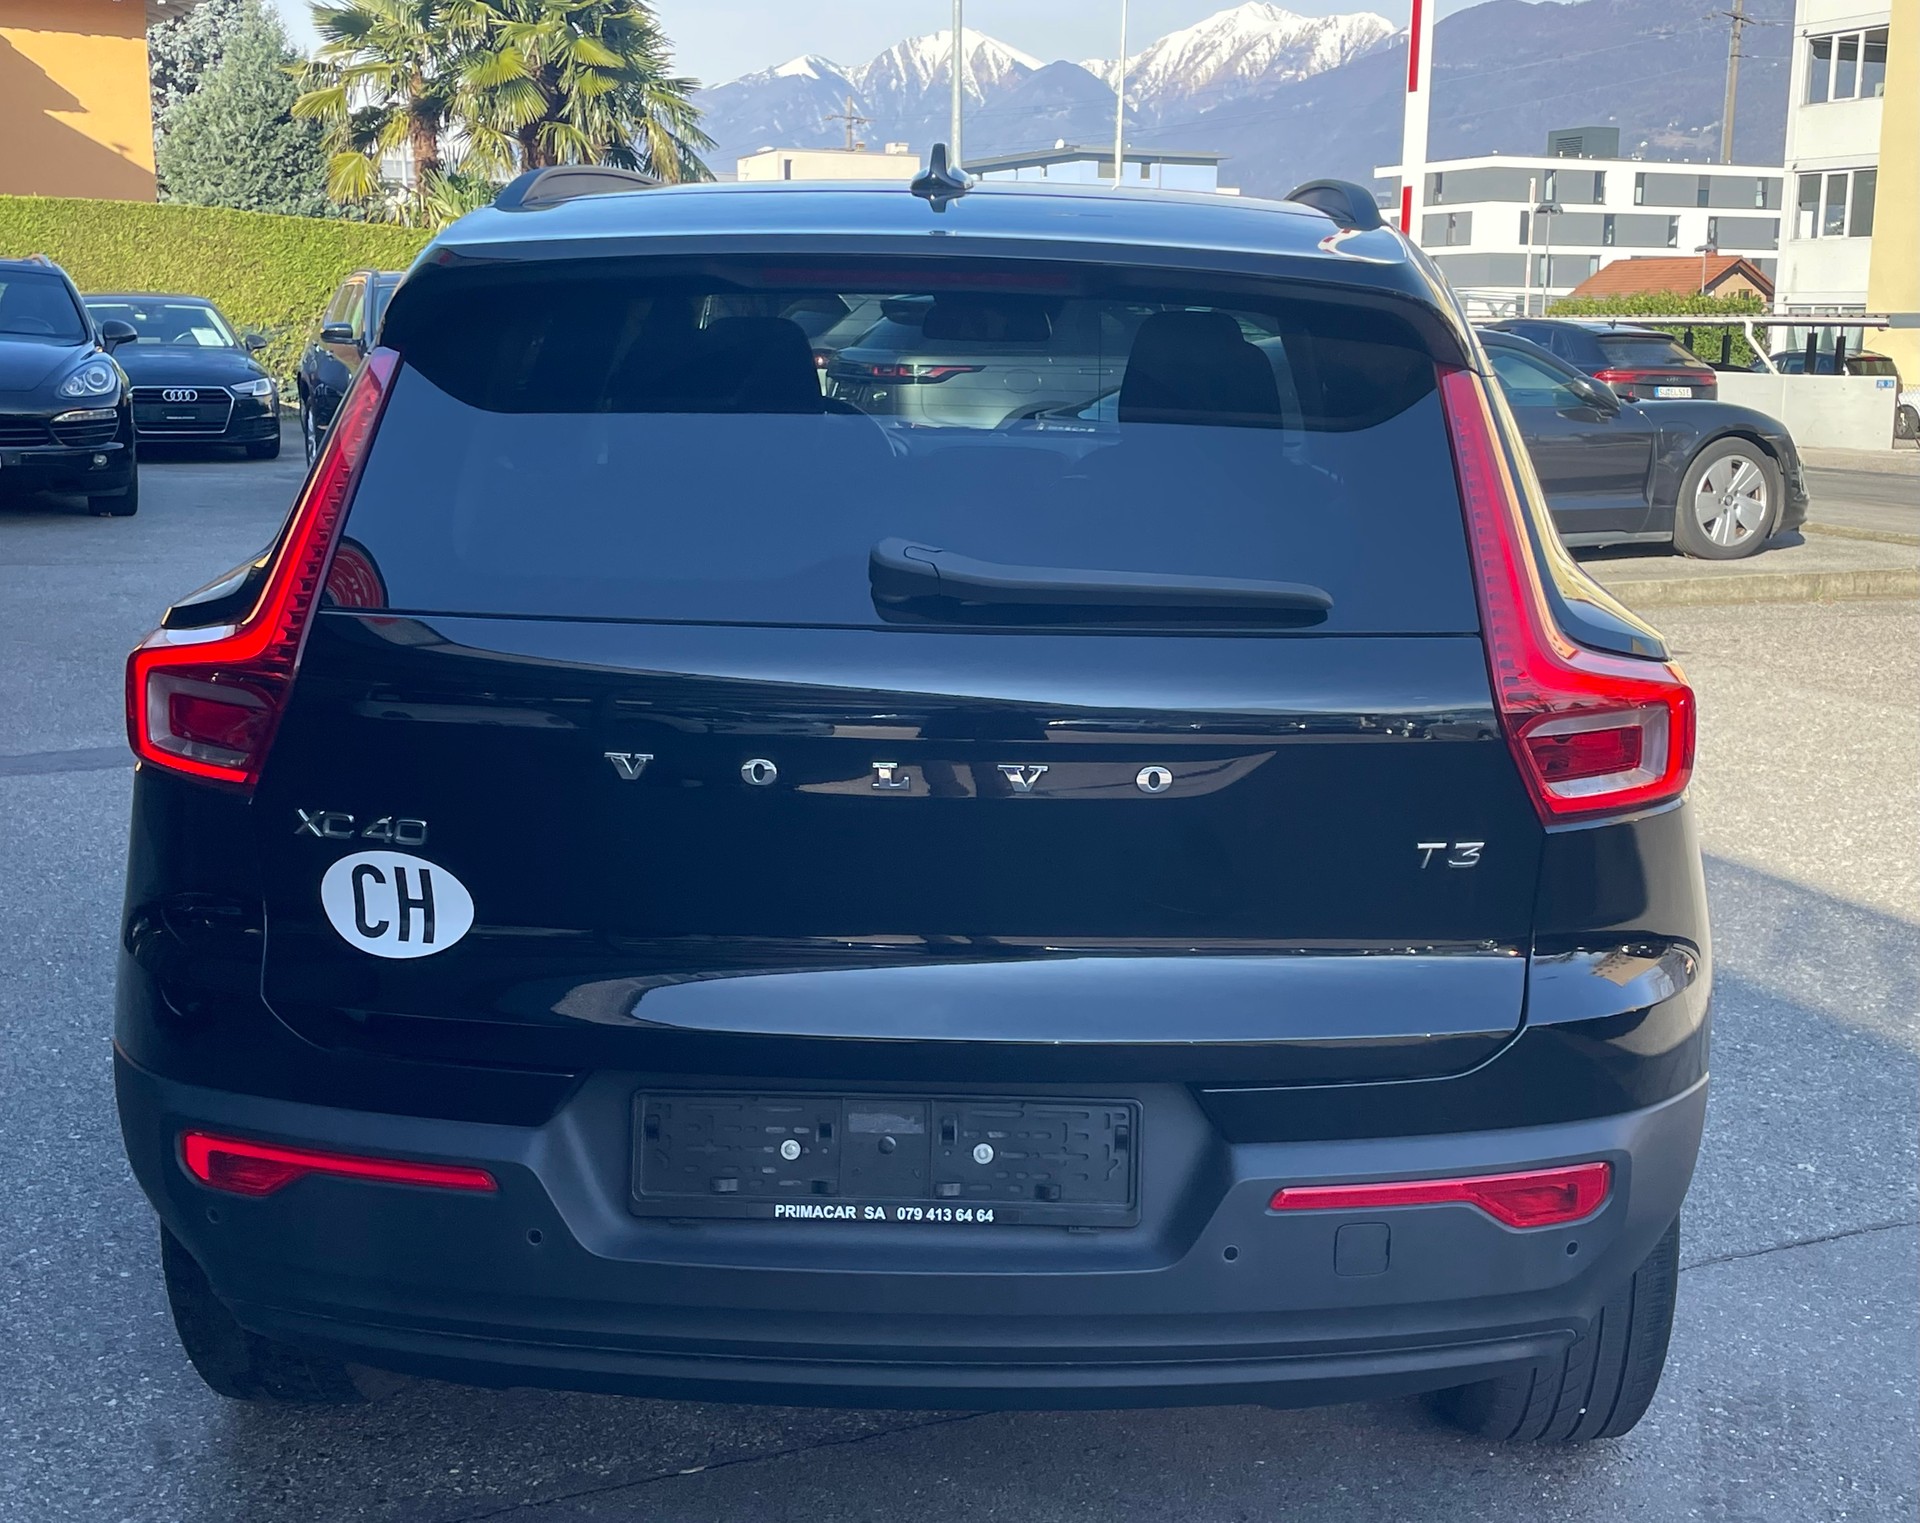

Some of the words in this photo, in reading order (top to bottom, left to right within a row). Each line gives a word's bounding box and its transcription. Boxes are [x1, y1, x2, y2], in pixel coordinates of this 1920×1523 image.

[604, 751, 1173, 794] VOLVO
[1417, 842, 1485, 869] T3
[351, 863, 436, 944] CH
[775, 1204, 857, 1219] PRIMACAR
[864, 1206, 886, 1220] SA
[897, 1207, 923, 1221] 079
[925, 1207, 952, 1221] 413
[955, 1208, 973, 1222] 64
[976, 1208, 995, 1223] 64
